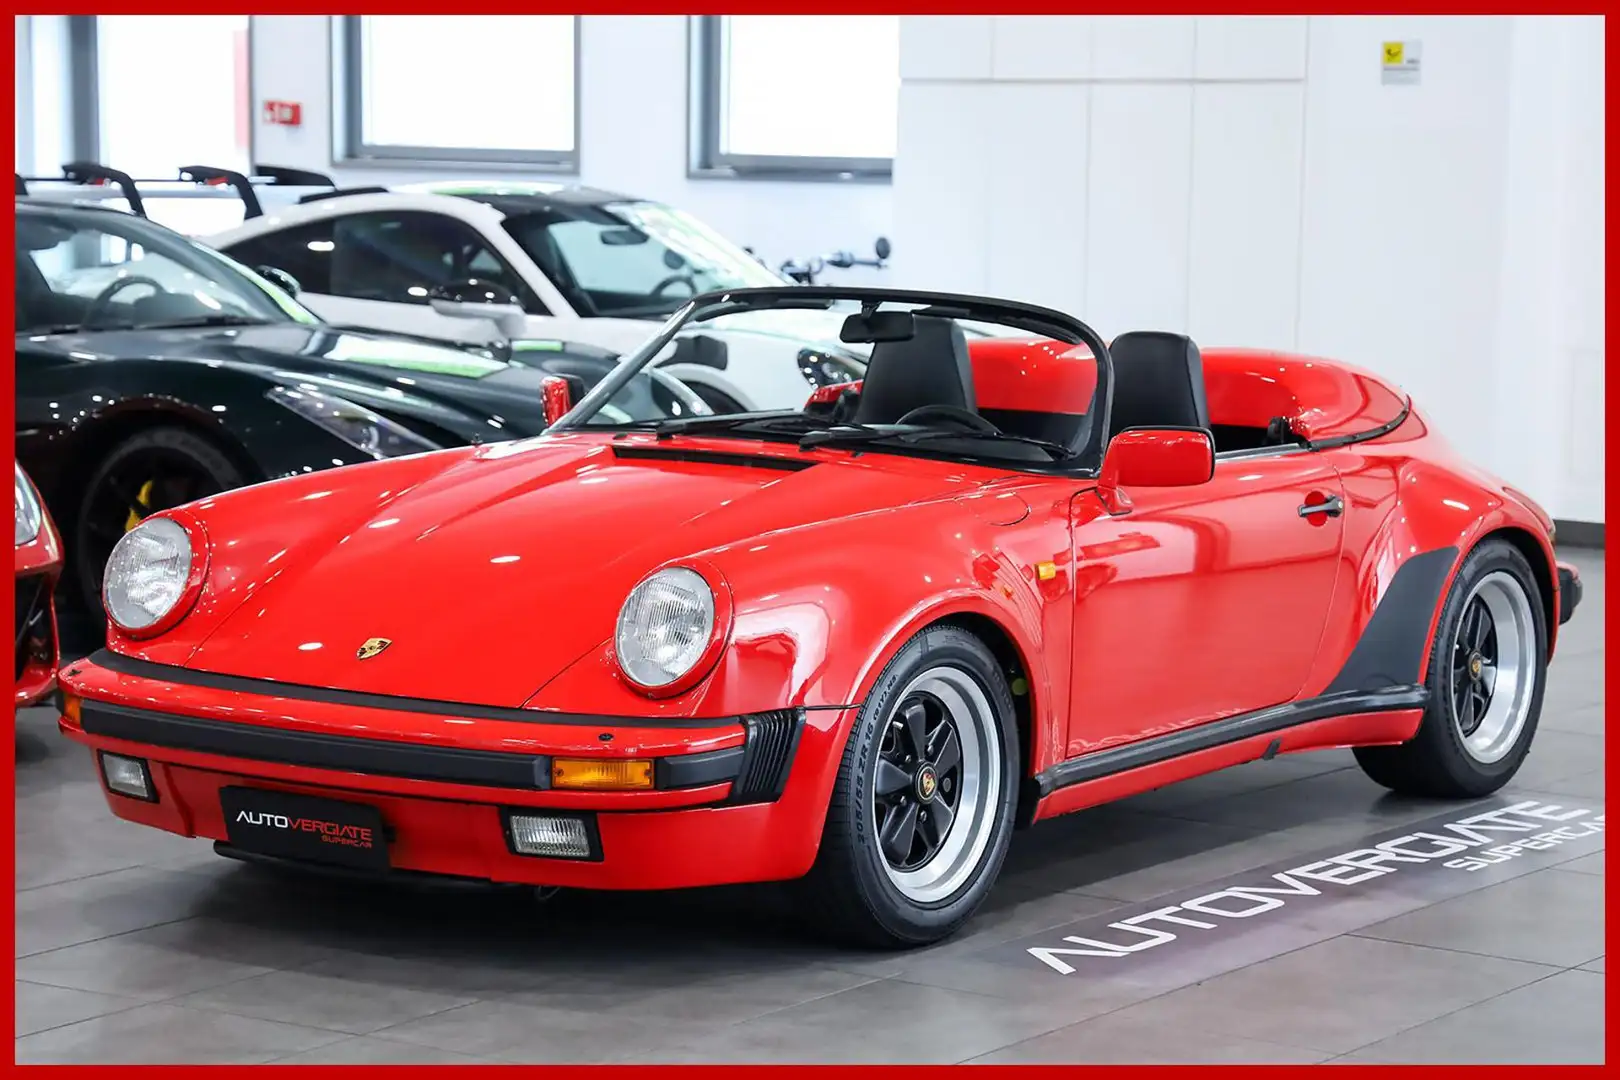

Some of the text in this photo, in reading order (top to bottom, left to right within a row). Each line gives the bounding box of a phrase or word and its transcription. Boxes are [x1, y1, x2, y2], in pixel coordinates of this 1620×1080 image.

[236, 810, 372, 841] AUTOVERGIATE
[321, 835, 372, 848] SUPERCAR
[1442, 815, 1605, 872] SUPERCA
[1026, 801, 1592, 975] AUTOVERGIATE
